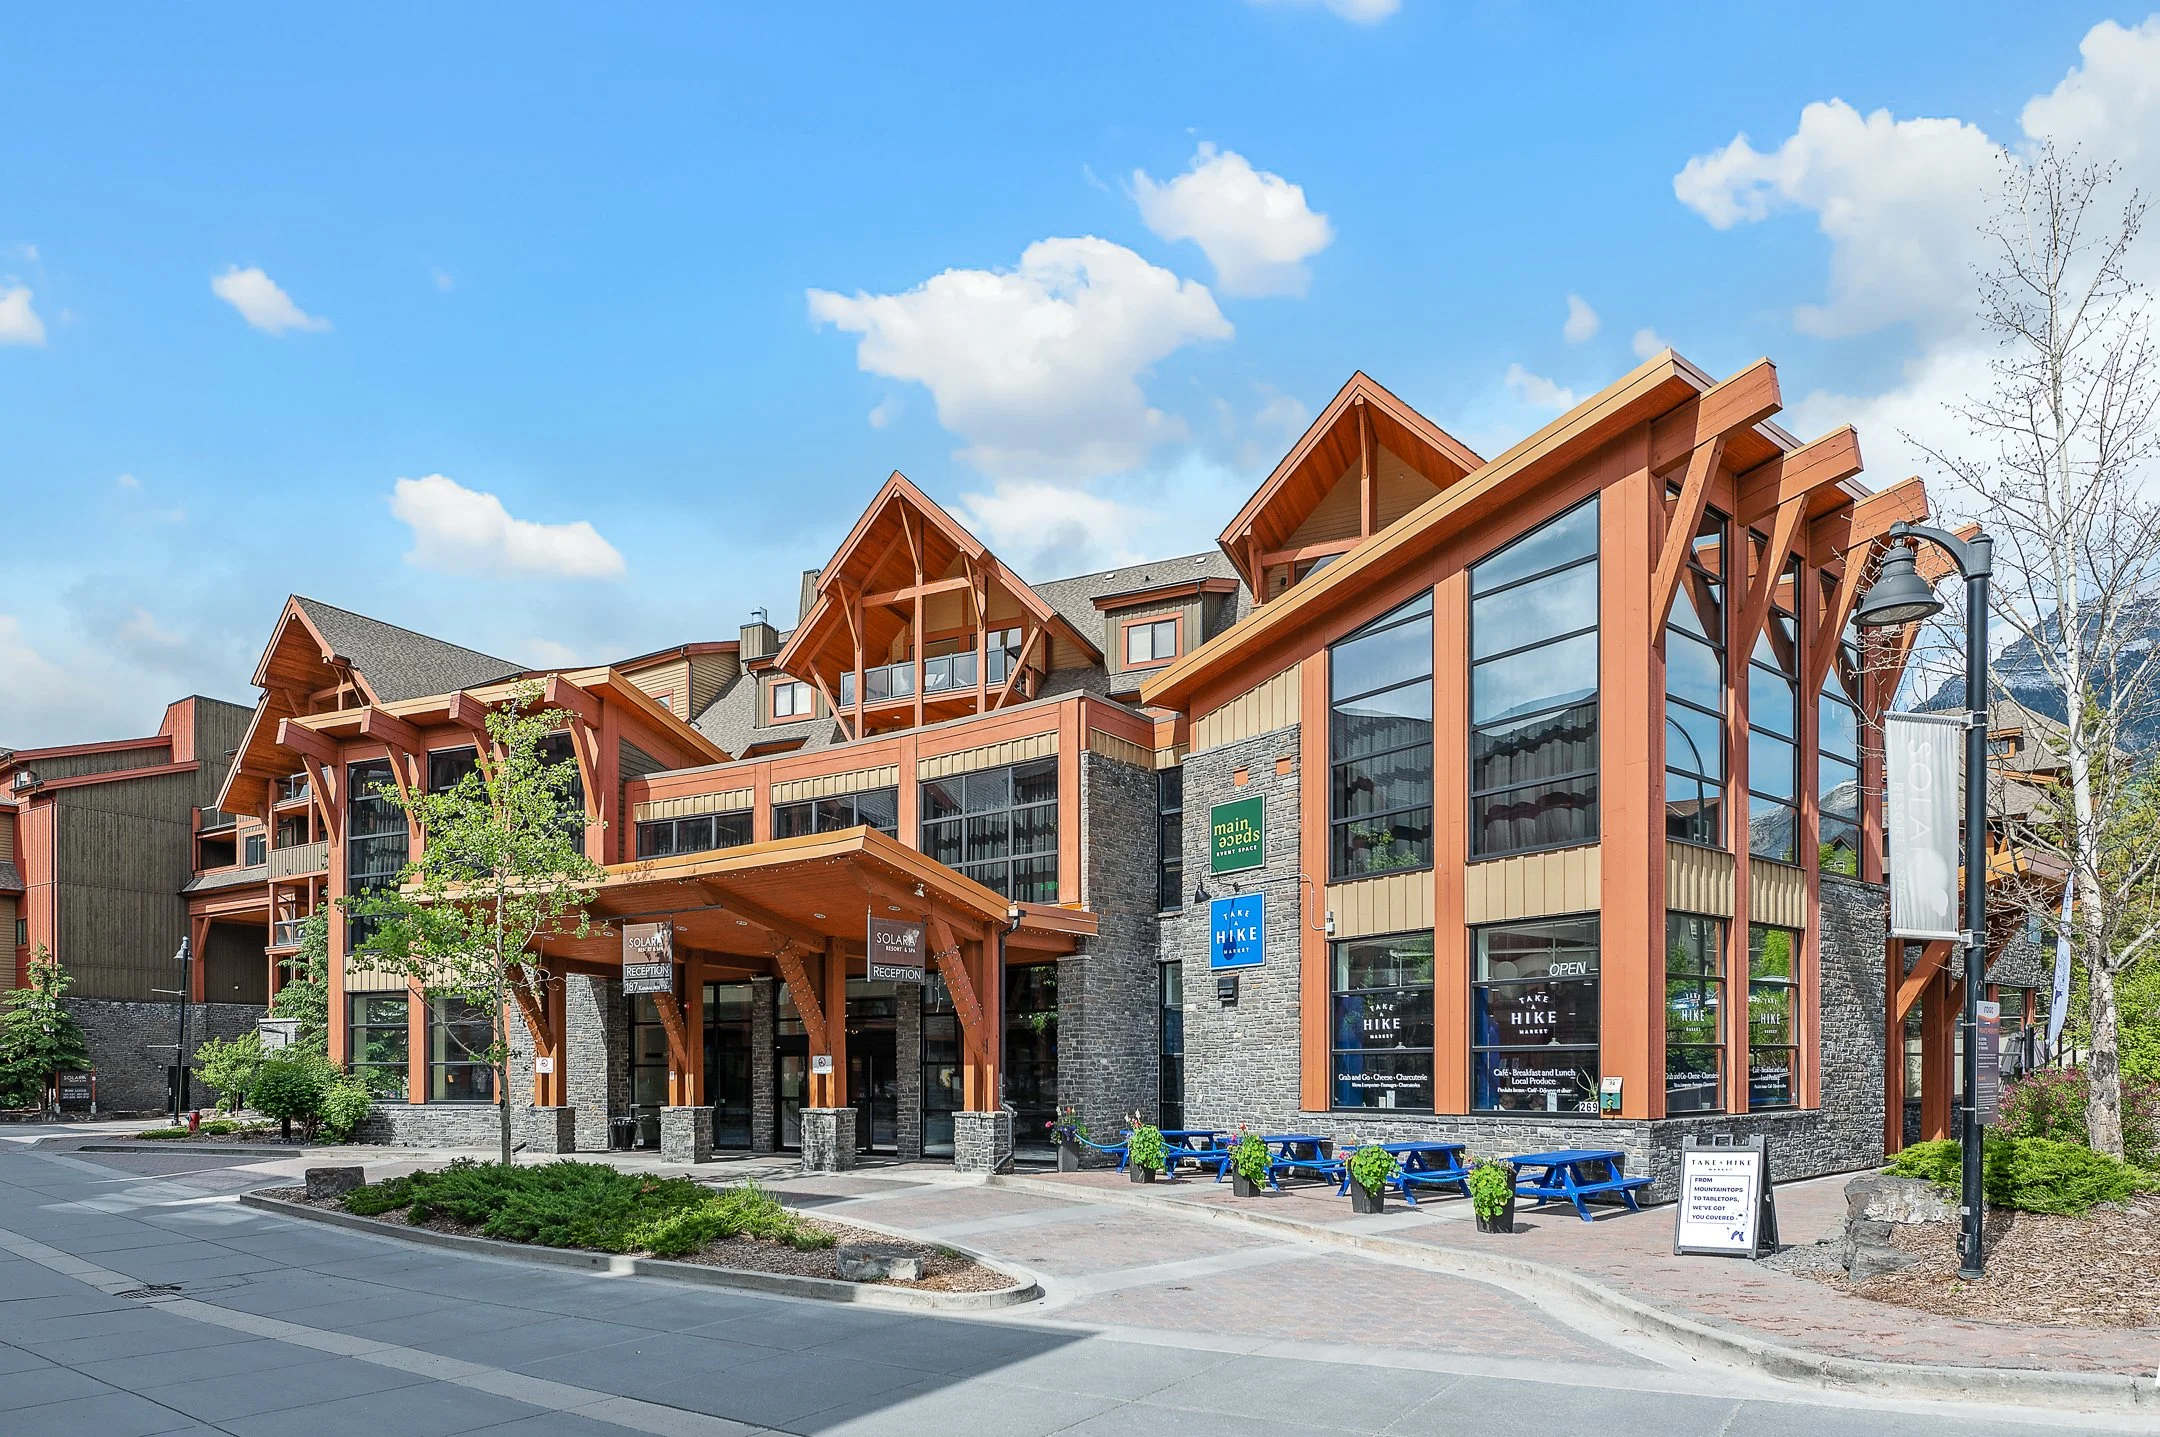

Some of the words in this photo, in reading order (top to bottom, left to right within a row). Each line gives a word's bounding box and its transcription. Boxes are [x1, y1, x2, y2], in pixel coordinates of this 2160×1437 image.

[1213, 817, 1249, 836] main
[1216, 849, 1236, 857] EVENT
[1238, 844, 1257, 853] SPACE
[1223, 909, 1250, 921] TAKE
[876, 932, 916, 947] SOLARA
[1216, 926, 1257, 945] HIKE
[628, 936, 664, 948] SOLARA
[1223, 947, 1250, 955] MARKET
[626, 965, 669, 977] RECEPTION
[873, 966, 921, 980] RECEPTION
[1549, 961, 1587, 976] OPEN
[625, 981, 639, 992] 187
[1518, 994, 1549, 1005] TAKE
[1369, 1003, 1395, 1012] TAKE
[1511, 1011, 1557, 1025] HIKE
[1681, 1009, 1705, 1022] HIKE
[1760, 1013, 1781, 1025] HIKE
[1363, 1018, 1401, 1031] HIKE
[1373, 1073, 1393, 1081] Cheese
[1395, 1073, 1428, 1081] Charcuterie
[1493, 1069, 1508, 1077] Café
[1512, 1069, 1541, 1077] Breakfast
[1541, 1069, 1555, 1077] and
[1555, 1069, 1576, 1077] Lunch
[1511, 1077, 1529, 1085] Local
[1530, 1077, 1557, 1085] Produce
[1580, 1102, 1598, 1112] 269
